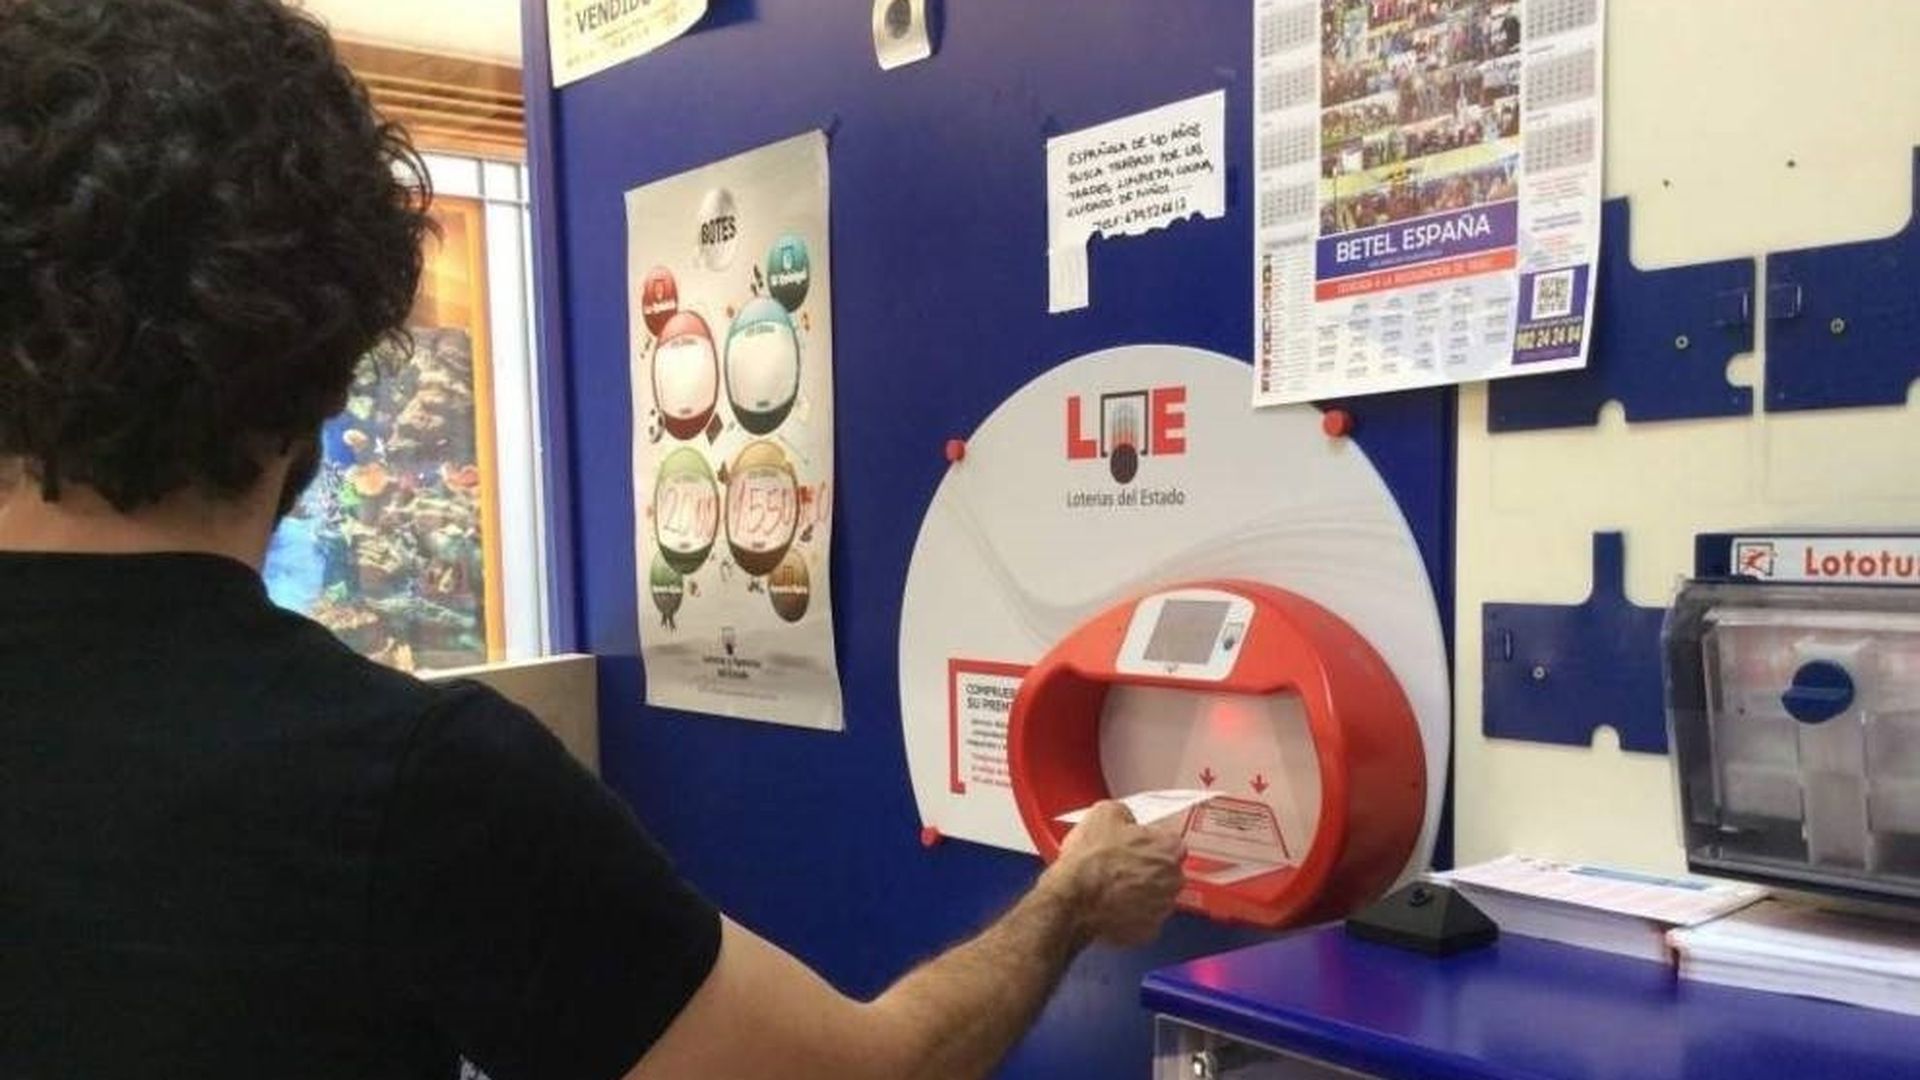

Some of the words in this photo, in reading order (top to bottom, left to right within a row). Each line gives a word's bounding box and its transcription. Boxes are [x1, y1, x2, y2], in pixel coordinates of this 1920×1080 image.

[576, 0, 652, 34] VENDI
[1068, 141, 1127, 166] ESPAÑOLA
[1132, 136, 1147, 150] DE
[1151, 133, 1168, 147] 40
[1171, 122, 1201, 140] AÑOS
[1068, 168, 1102, 185] BUSCA
[1107, 154, 1154, 172] TRABAJO
[1160, 149, 1182, 164] POR
[1185, 143, 1204, 158] LAS
[1119, 191, 1135, 205] DE
[701, 215, 737, 246] BOTES
[1335, 231, 1397, 263] BETEL
[1402, 213, 1491, 251] ESPAÑA
[1117, 489, 1137, 506] del
[1140, 487, 1185, 505] Estado
[1805, 547, 1920, 577] Lototu
[966, 697, 981, 709] SU
